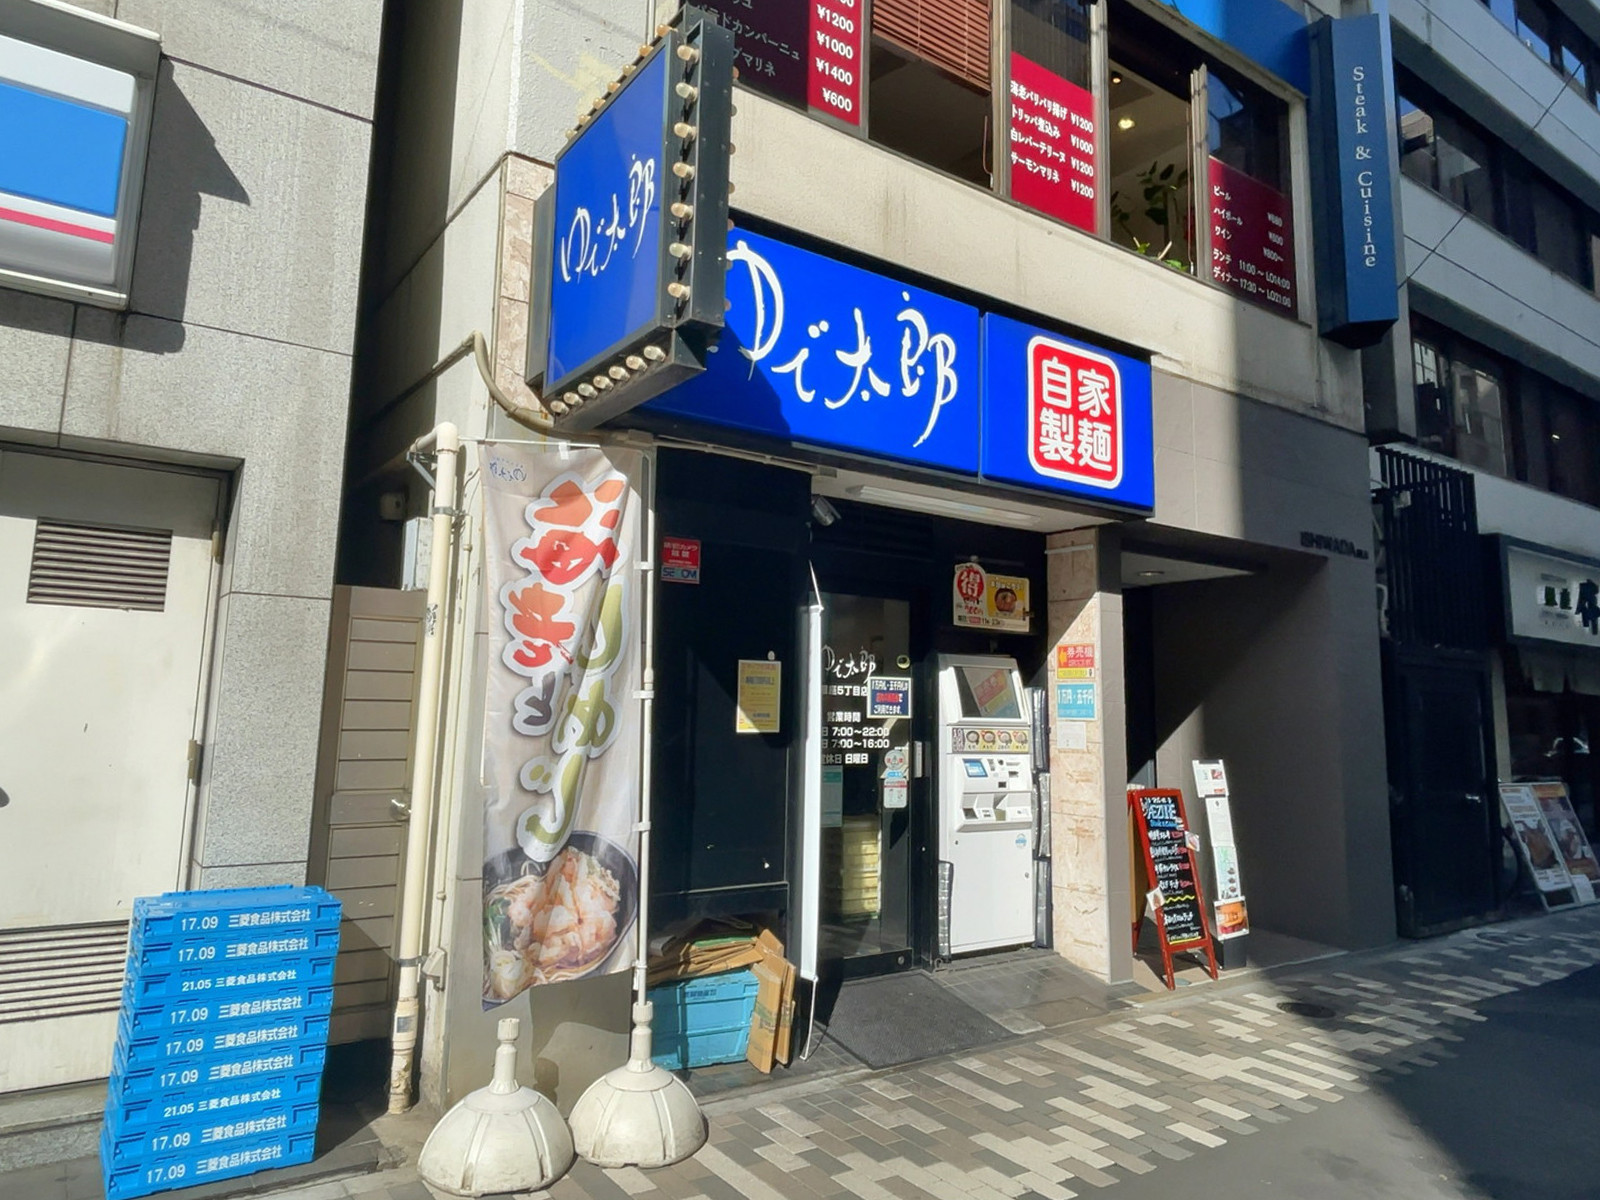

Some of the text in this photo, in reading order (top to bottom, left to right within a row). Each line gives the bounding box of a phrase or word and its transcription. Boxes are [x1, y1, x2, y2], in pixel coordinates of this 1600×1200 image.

[816, 4, 855, 34] ¥1200
[816, 31, 854, 59] ¥1000
[815, 57, 853, 85] ¥1400
[822, 87, 853, 112] ¥600
[1070, 112, 1093, 133] ¥1200
[1070, 134, 1094, 155] ¥1000
[1011, 151, 1095, 199] サーモンマリネ ¥1200
[1070, 156, 1094, 177] ¥1200
[1353, 66, 1377, 267] Steak & Cuisine
[1213, 185, 1231, 200] ビール
[561, 154, 655, 284] ゆで太郎
[1215, 225, 1232, 240] ワイン
[1213, 248, 1232, 264] ランチ
[1213, 266, 1239, 283] ディナー
[1041, 356, 1110, 418] 自家
[1039, 408, 1113, 472] 製麺
[1066, 646, 1094, 658] 券売機
[827, 711, 861, 723] 営業時間
[845, 753, 869, 764] 日曜日
[181, 909, 311, 932] 17.09 三菱食品株式会社
[178, 937, 309, 962] 17.09 三菱食品株式会社
[182, 970, 297, 992] 21.05 三菱食品株式会社
[170, 996, 302, 1025] 17.09 三菱食品株式会社
[165, 1025, 298, 1056] 17.09 三菱食品株式会社
[160, 1054, 294, 1088] 17.09 三菱食品株式会社
[163, 1088, 281, 1118] 21.05 三菱食品株式会社
[151, 1115, 287, 1151] 17.09 三菱食品株式会社
[147, 1145, 282, 1184] 17.09 三菱食品株式会社
